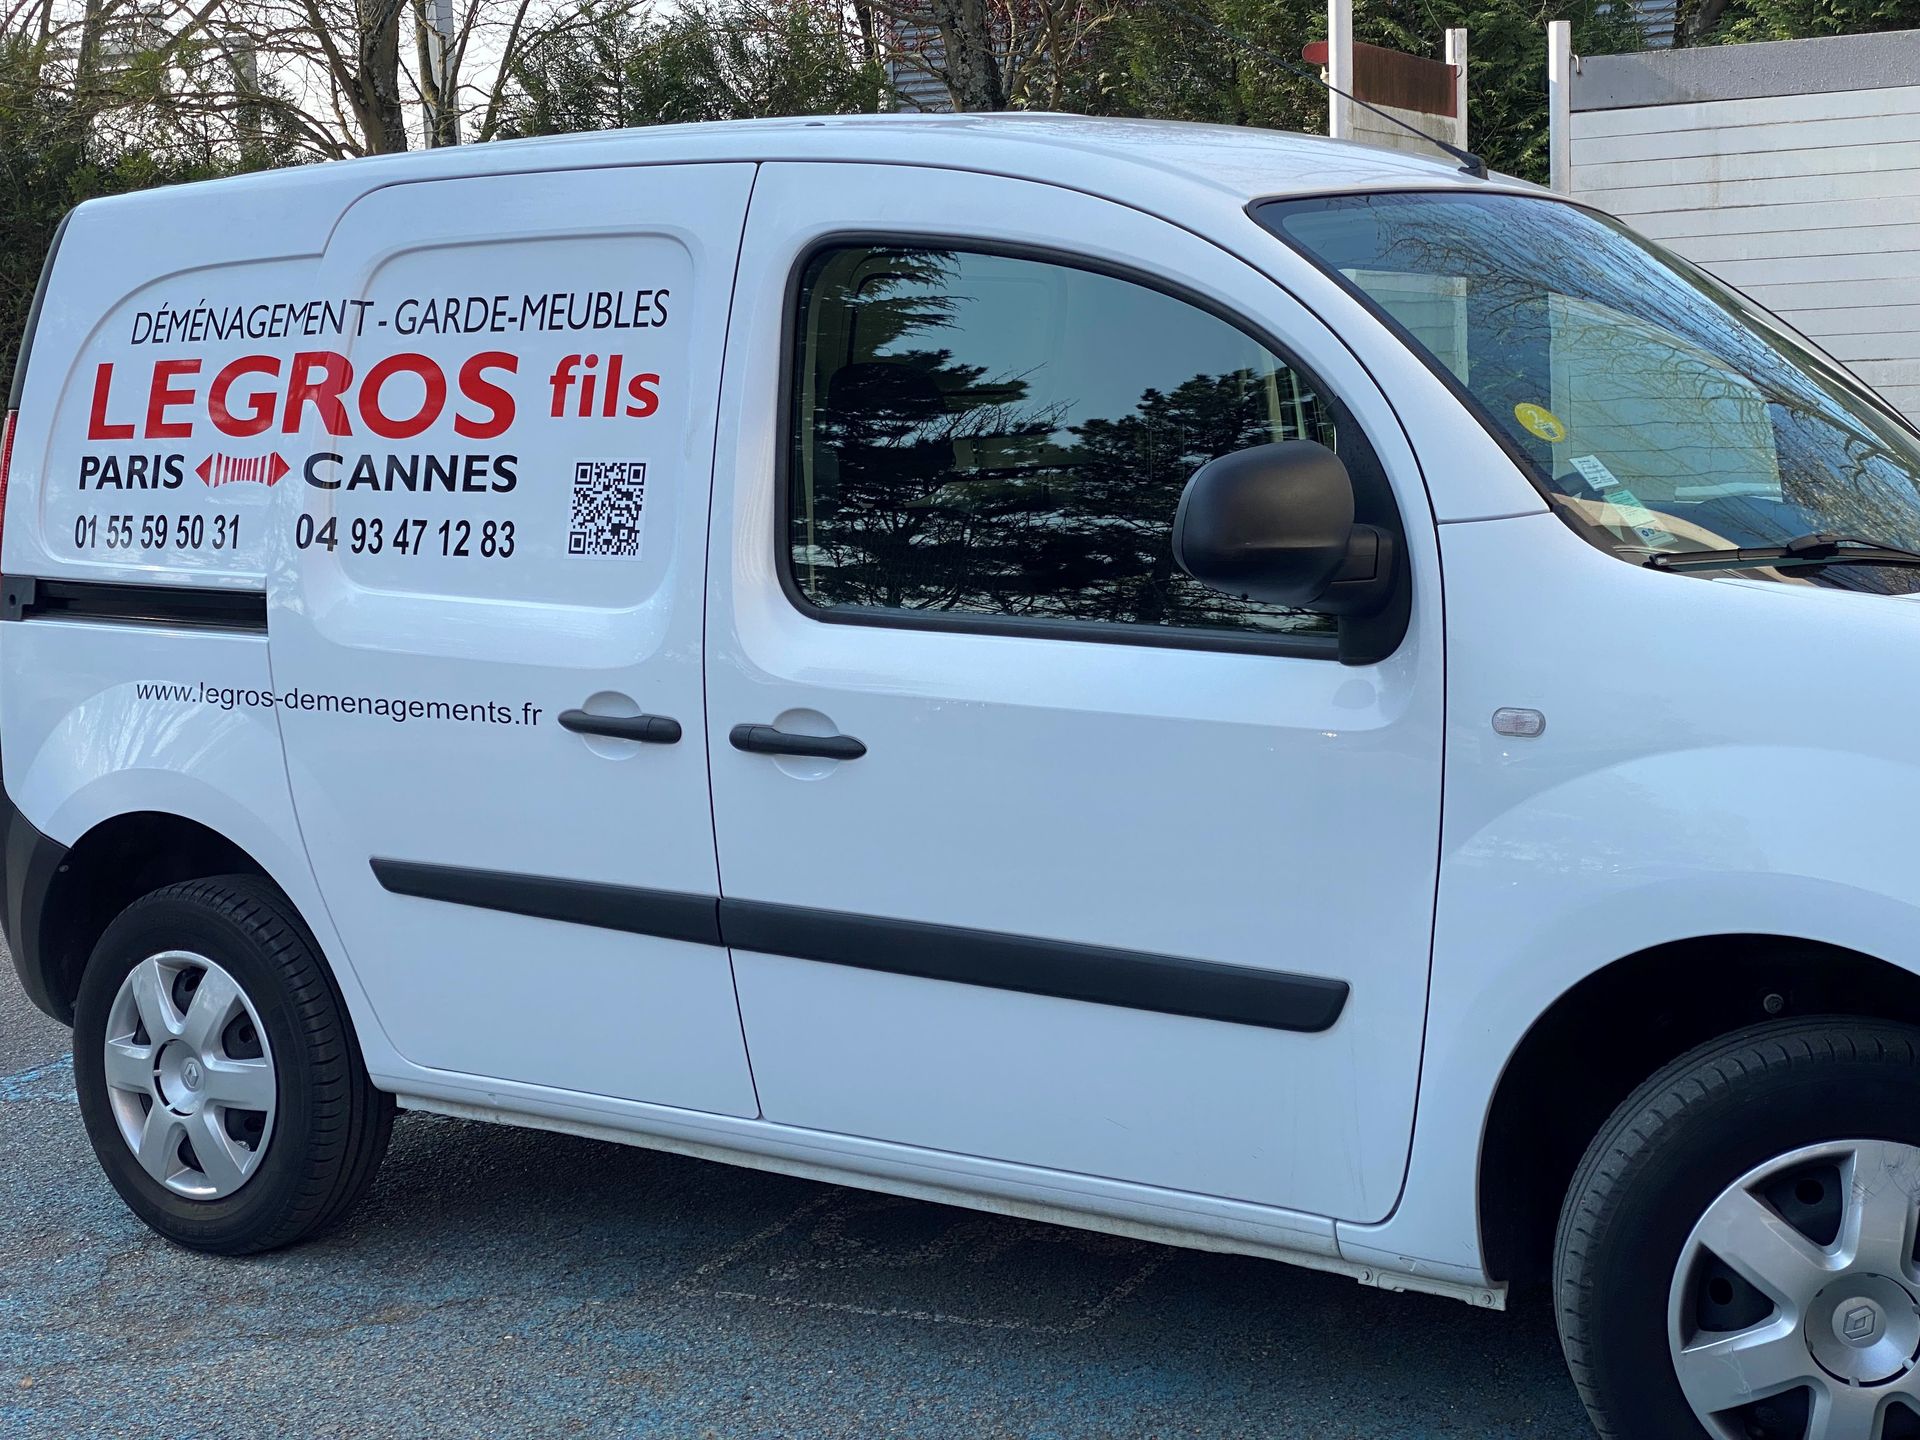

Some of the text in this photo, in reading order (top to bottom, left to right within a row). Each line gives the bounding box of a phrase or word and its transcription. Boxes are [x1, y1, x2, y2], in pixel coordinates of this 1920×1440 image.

[131, 298, 375, 345] DÉMÉNAGEMENT
[394, 288, 670, 336] GARDE-MEUBLES
[87, 351, 660, 441] LEGROS fils
[78, 452, 518, 494] PARIS CANNES
[74, 514, 240, 550] 01 55 59 50 31
[295, 513, 515, 559] 04 93 47 12 83
[136, 681, 543, 726] www.legros-demenagements.fr
